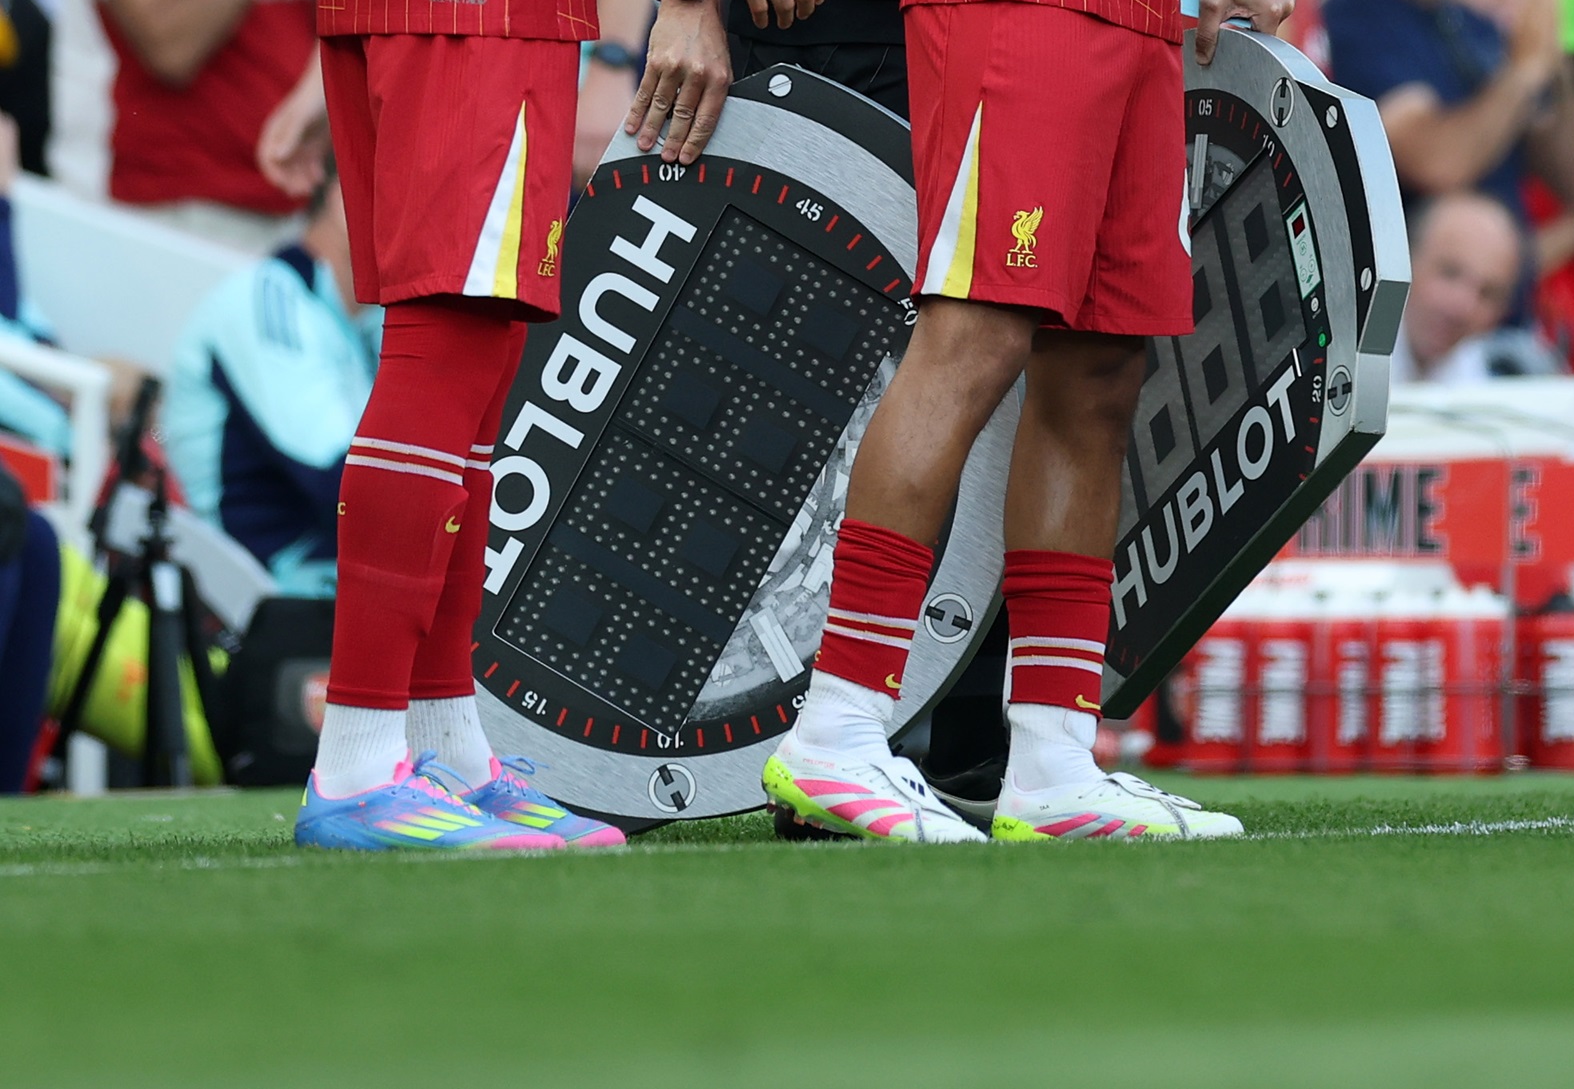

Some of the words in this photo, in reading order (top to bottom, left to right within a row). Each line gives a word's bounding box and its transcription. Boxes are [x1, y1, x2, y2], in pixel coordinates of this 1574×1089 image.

[1198, 99, 1213, 116] 05
[795, 198, 824, 222] 45
[482, 193, 699, 596] HUBLOT
[1311, 375, 1323, 403] 20
[1109, 364, 1297, 632] HUBLOT
